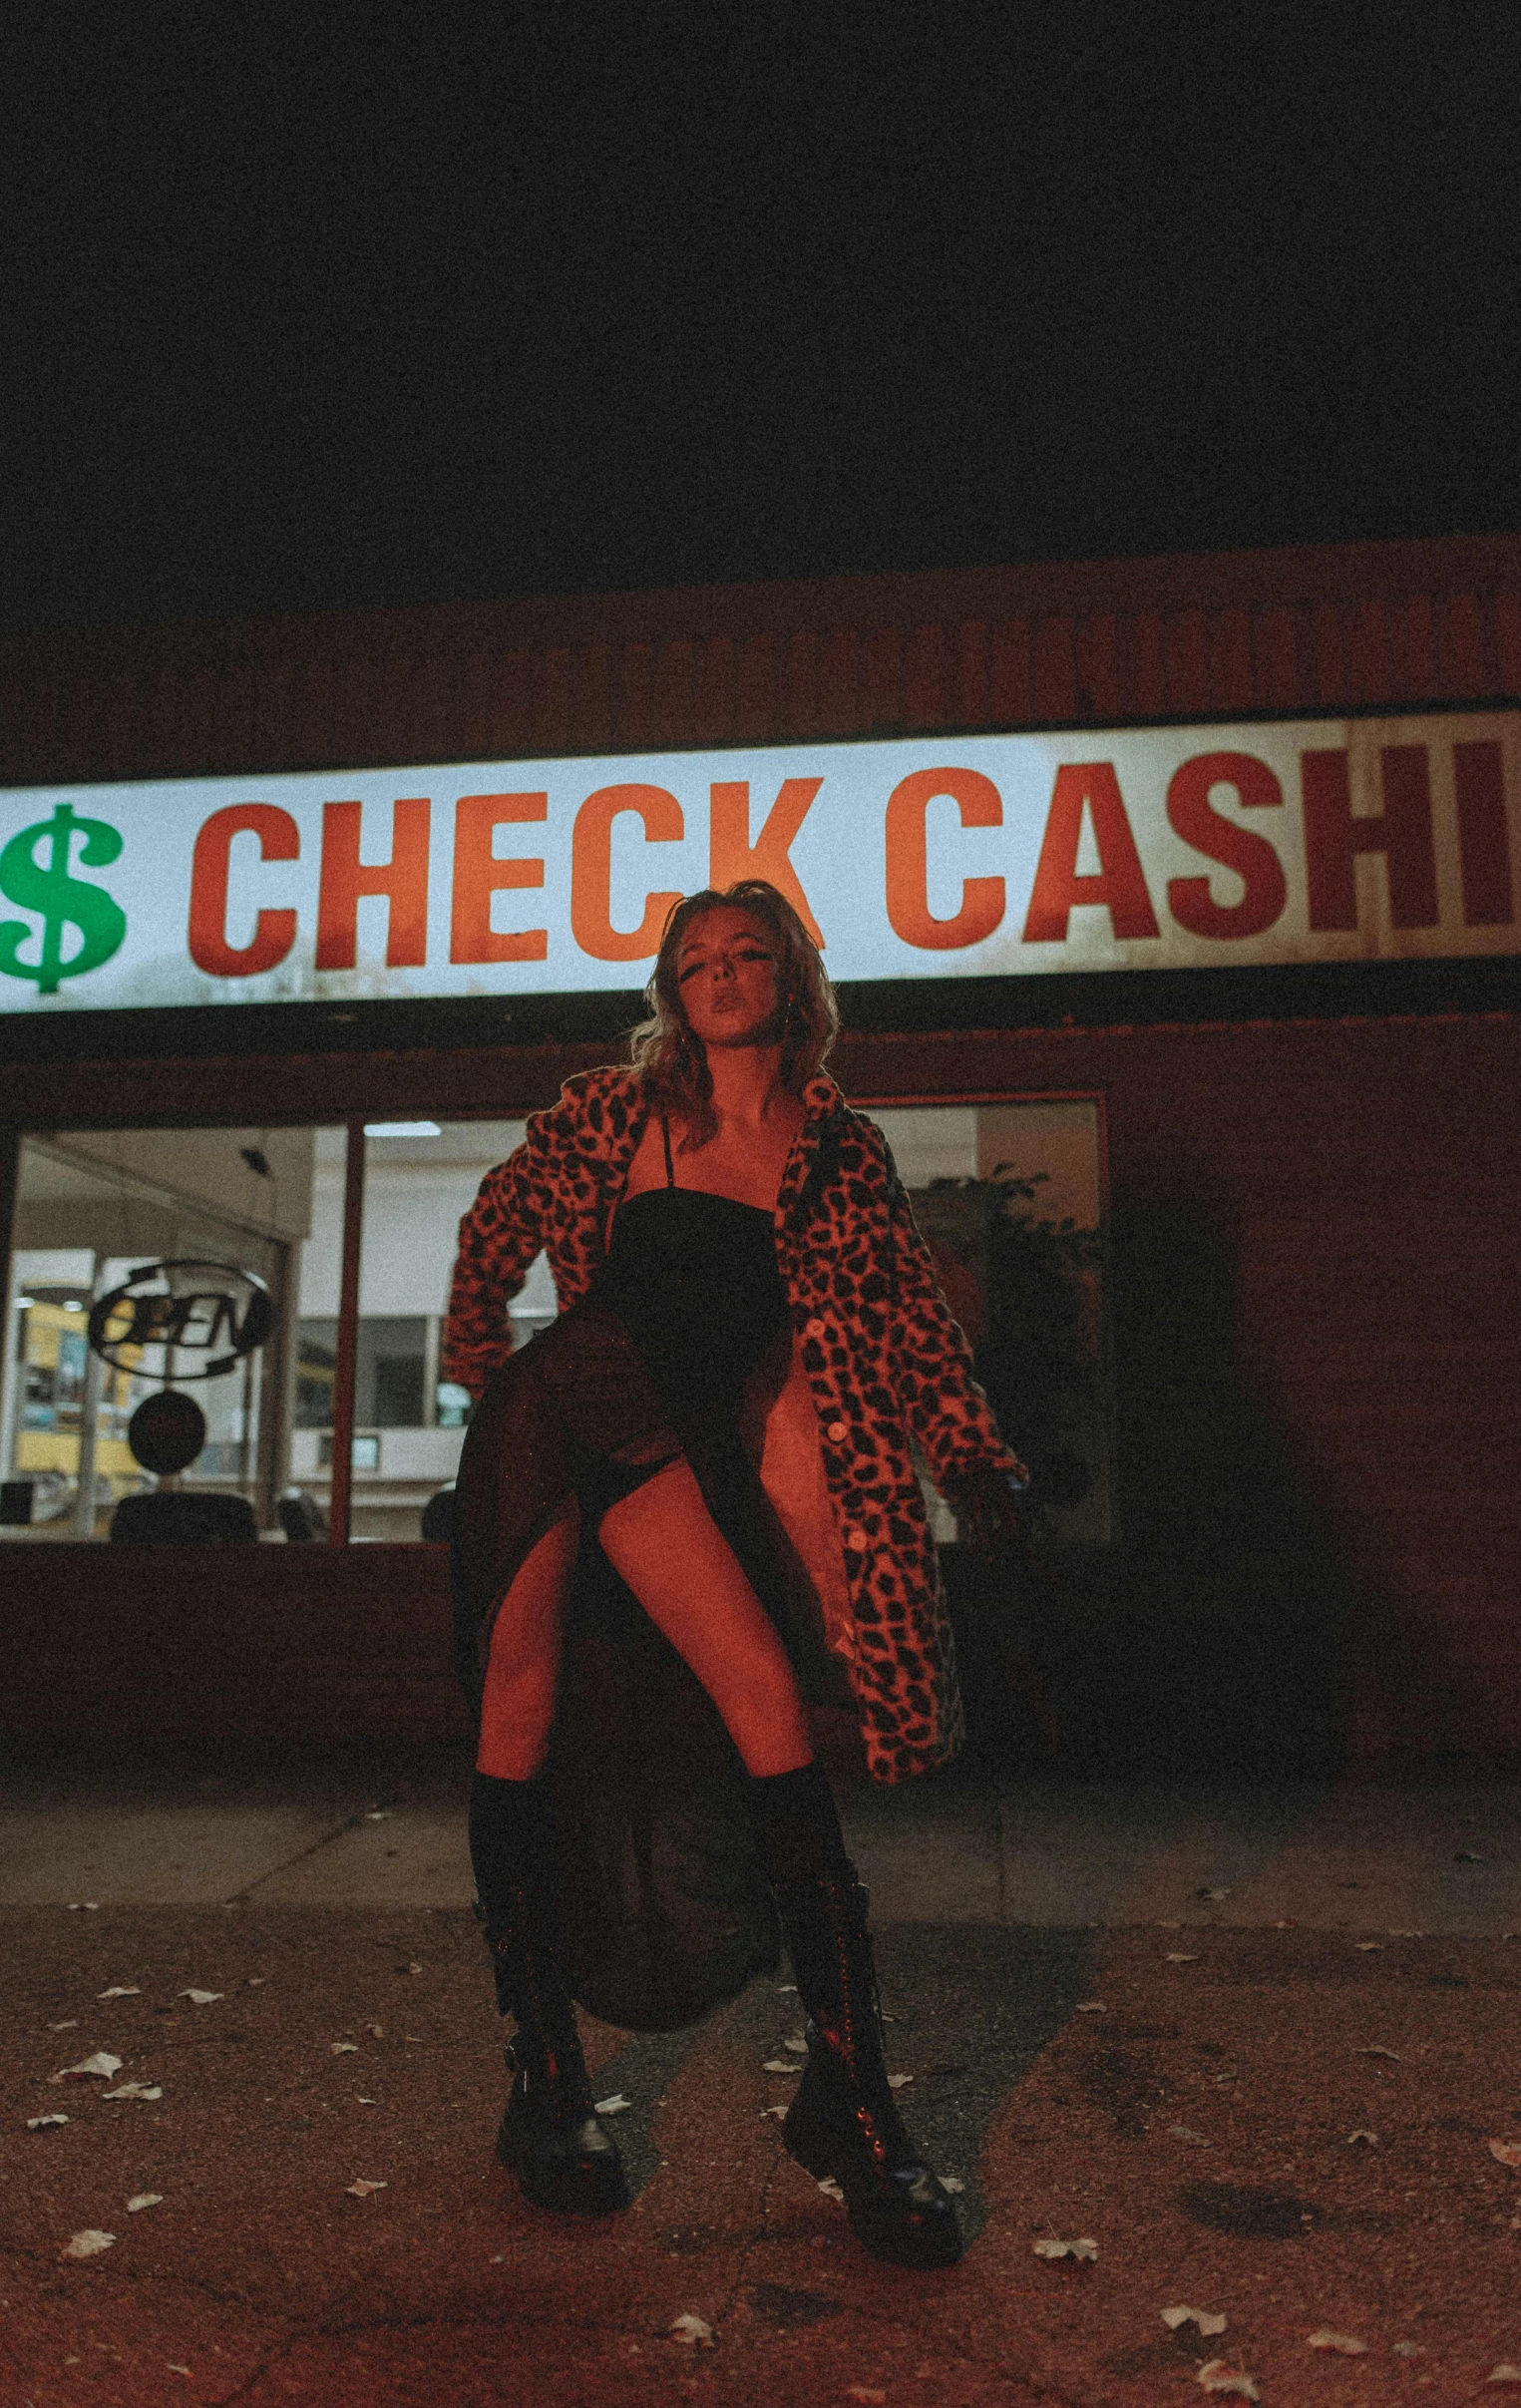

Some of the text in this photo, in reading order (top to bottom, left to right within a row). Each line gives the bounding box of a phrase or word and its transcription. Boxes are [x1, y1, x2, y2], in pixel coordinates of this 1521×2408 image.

[0, 803, 127, 994] $
[188, 777, 826, 978] CHECK
[95, 1294, 263, 1350] OPEN
